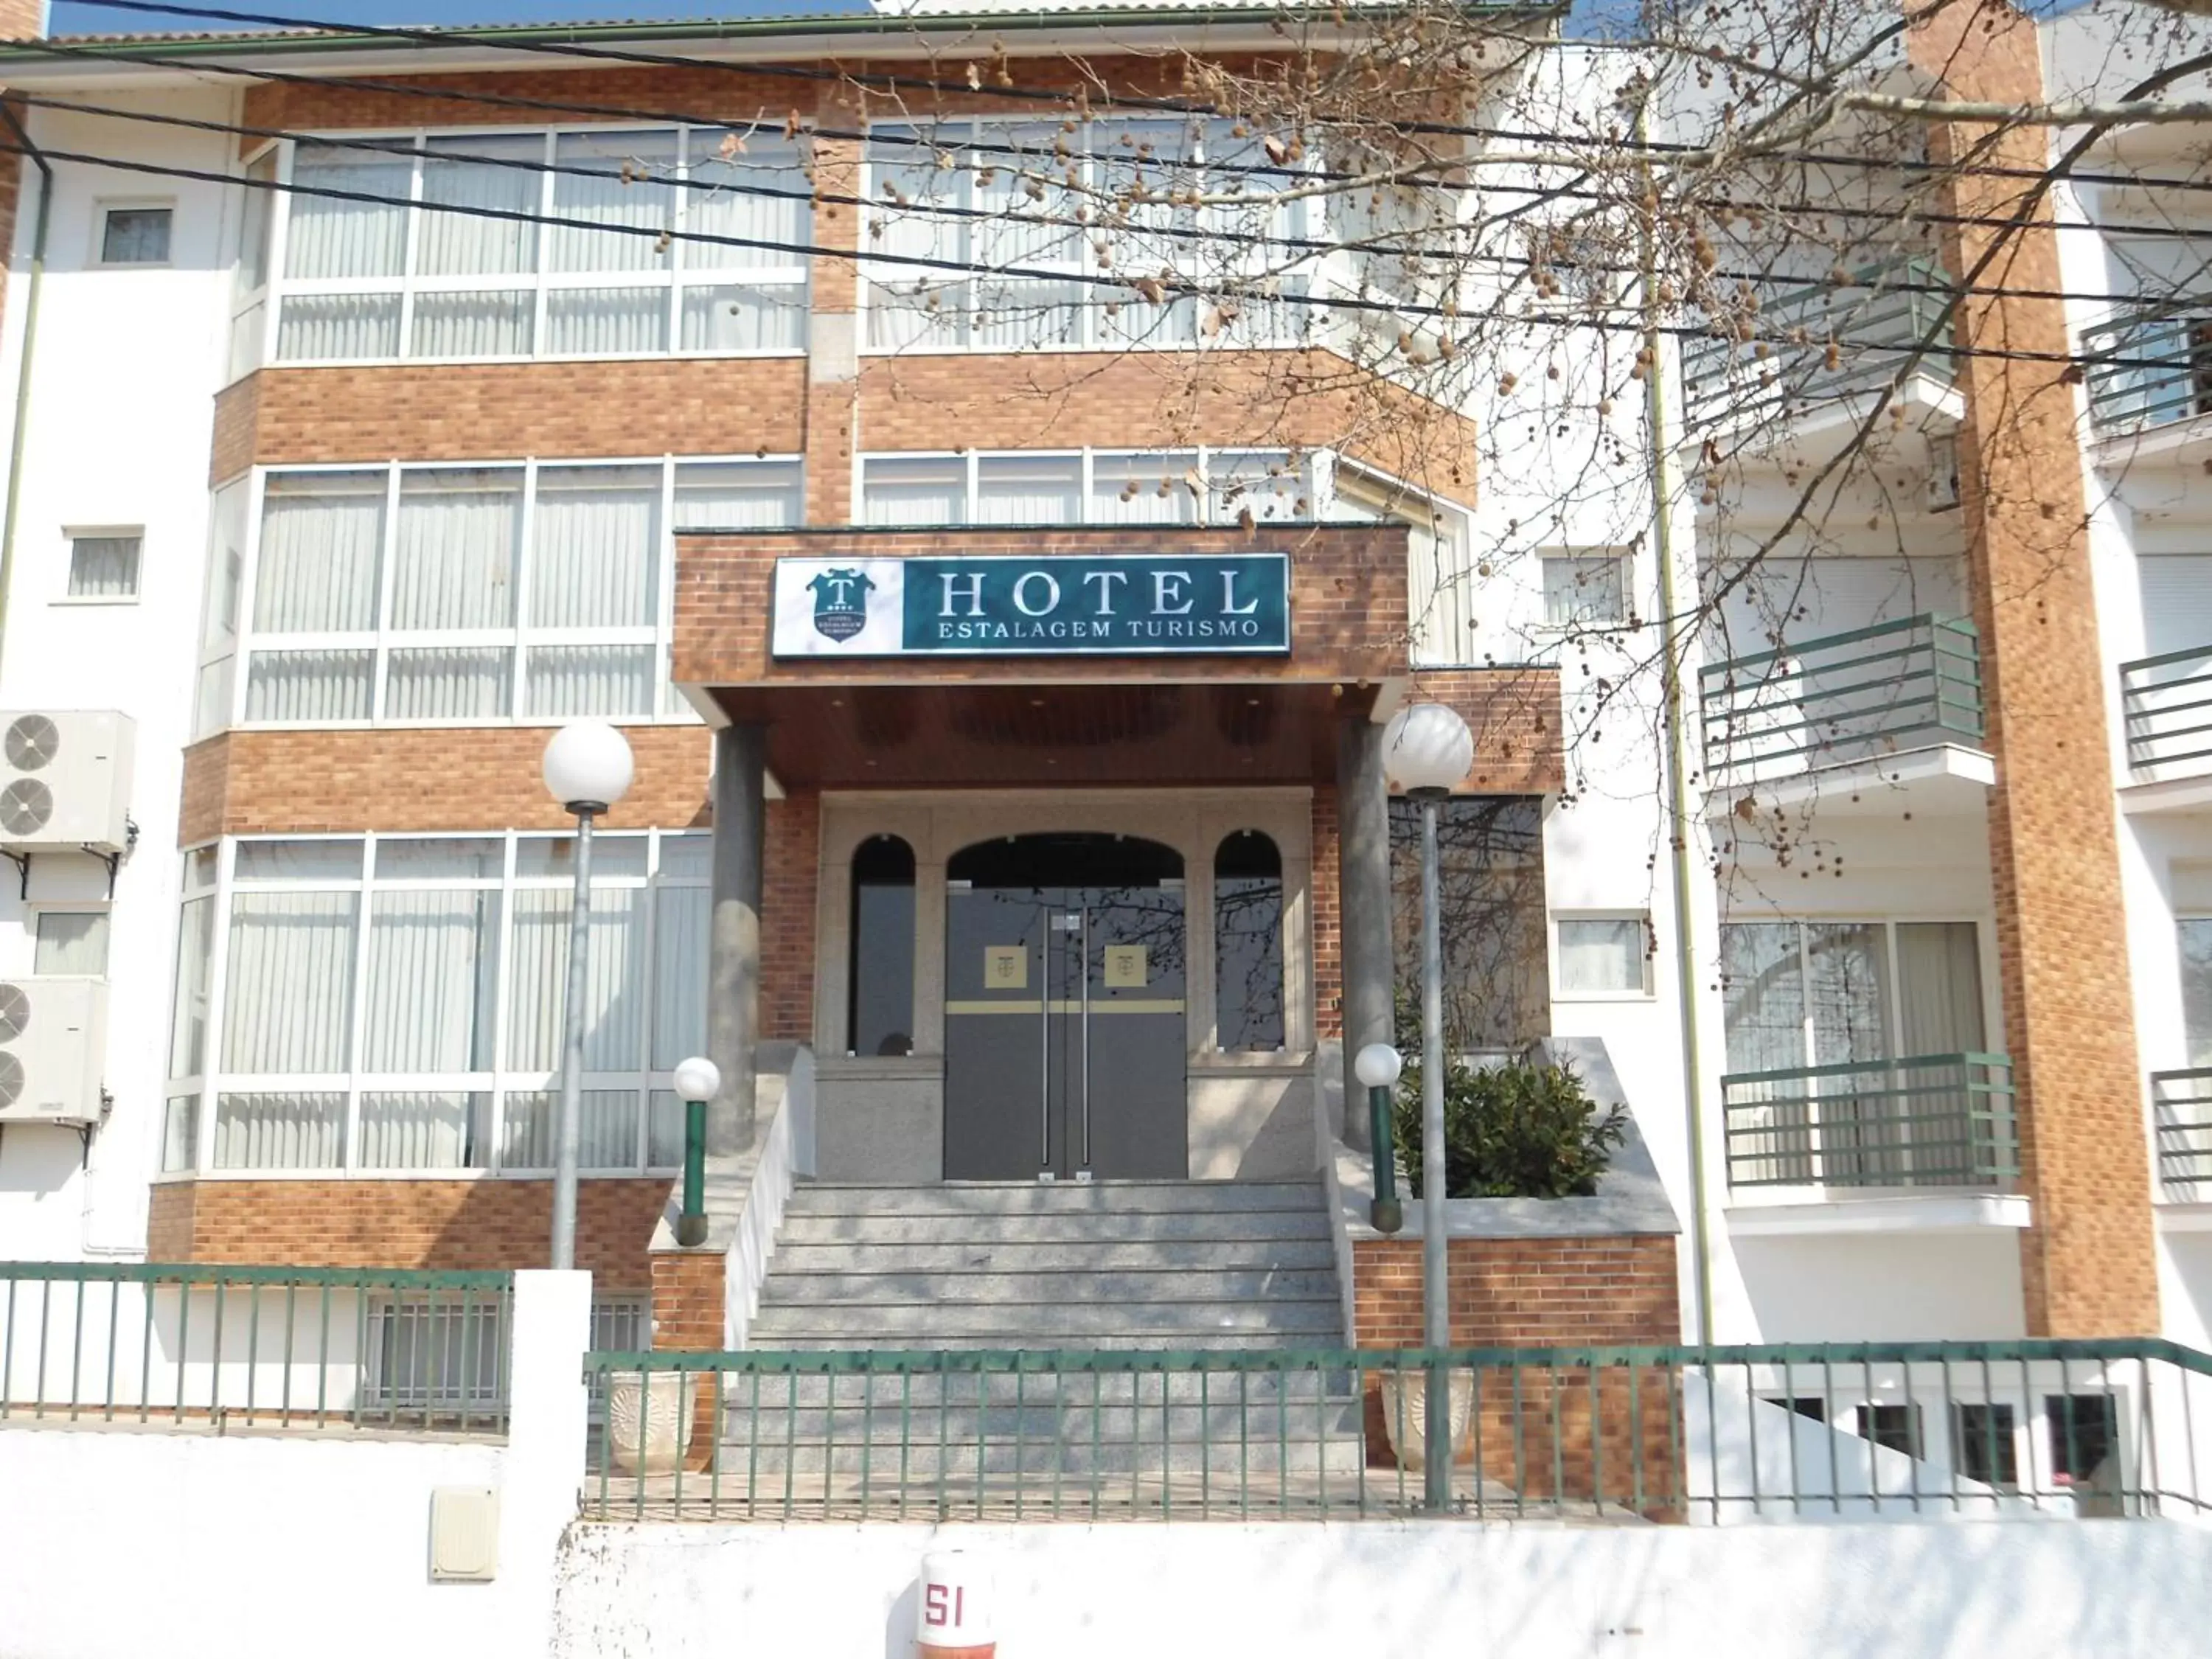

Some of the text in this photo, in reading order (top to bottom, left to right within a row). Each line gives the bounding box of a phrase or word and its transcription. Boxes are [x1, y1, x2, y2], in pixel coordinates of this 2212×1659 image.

[827, 579, 855, 605] T
[937, 570, 1259, 616] HOTEL
[939, 619, 1259, 639] ESTALAGEM TURISMO
